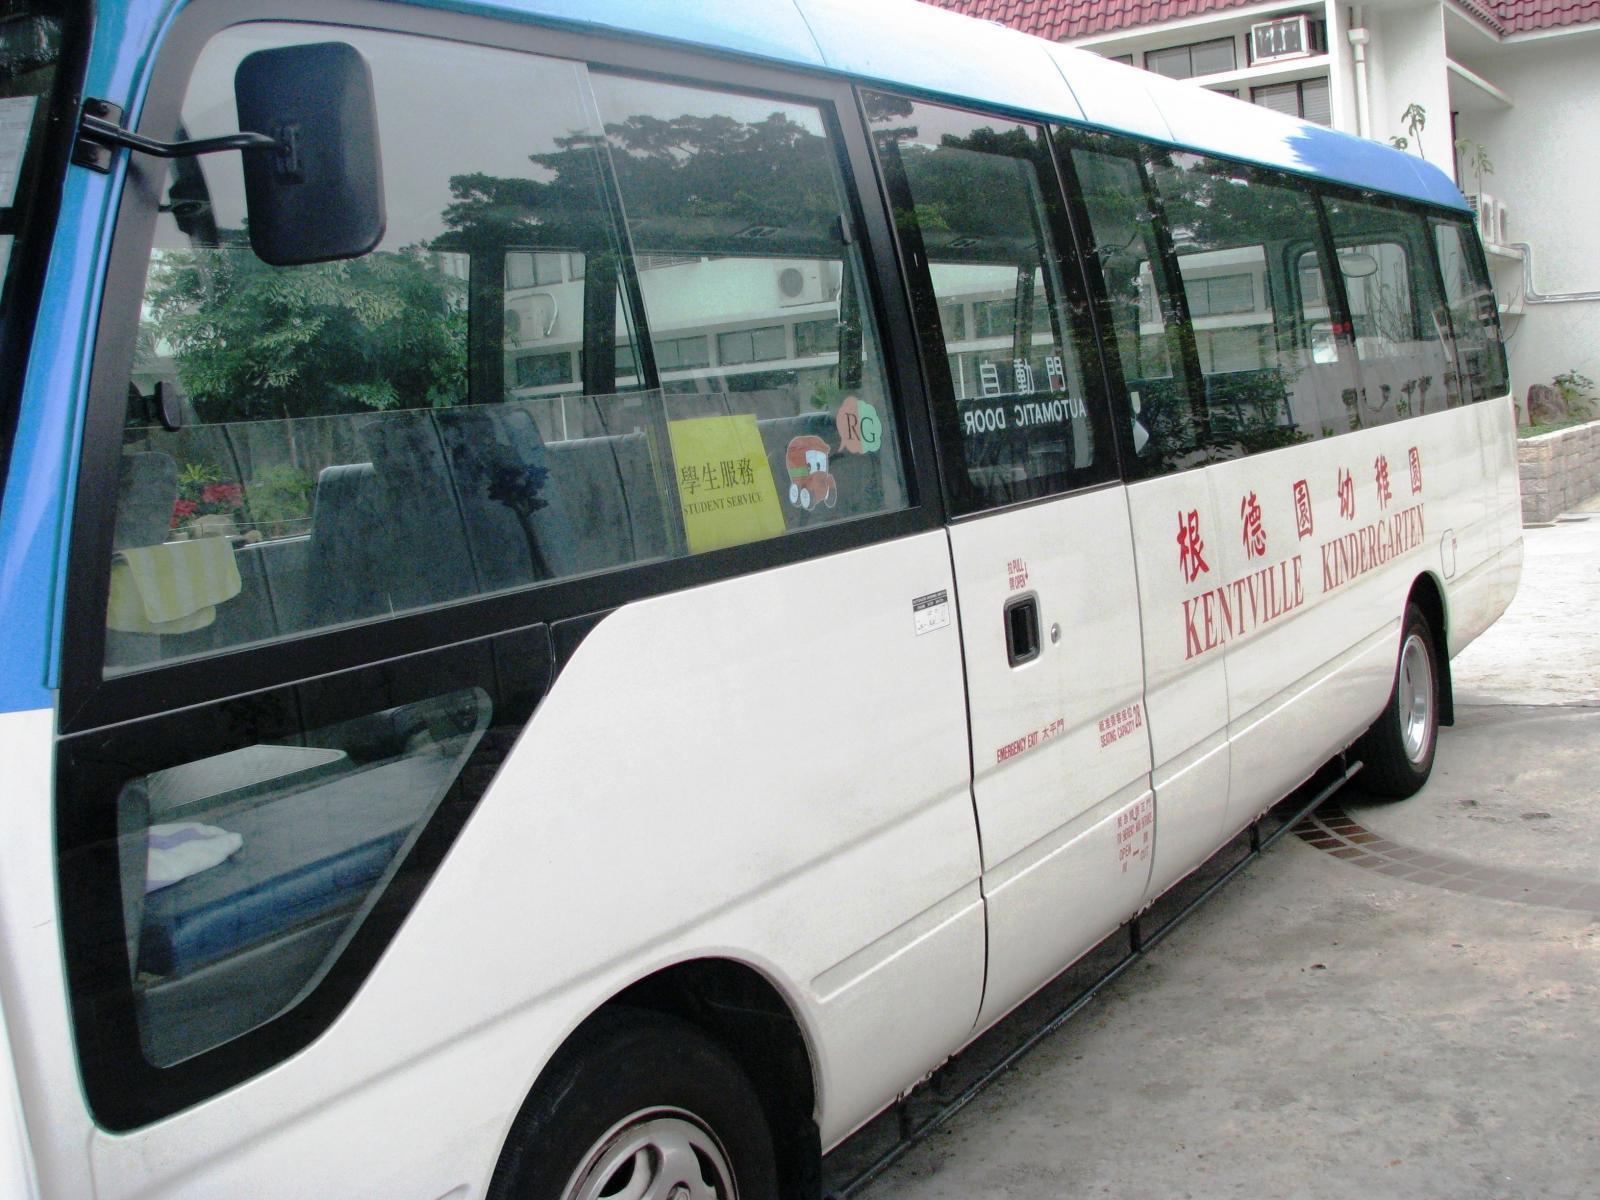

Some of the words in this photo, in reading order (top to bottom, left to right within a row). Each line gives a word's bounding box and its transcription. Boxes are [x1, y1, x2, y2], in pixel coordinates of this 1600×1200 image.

[979, 356, 1067, 397] 自動門
[681, 458, 755, 495] 學生服務
[684, 498, 725, 516] STUDENT
[727, 491, 764, 509] SERVICE
[1182, 554, 1304, 661] KENTVILLE
[1320, 503, 1425, 593] KINDERGARTEN
[996, 735, 1027, 764] EMERGENCY
[1027, 731, 1039, 749] EXIT
